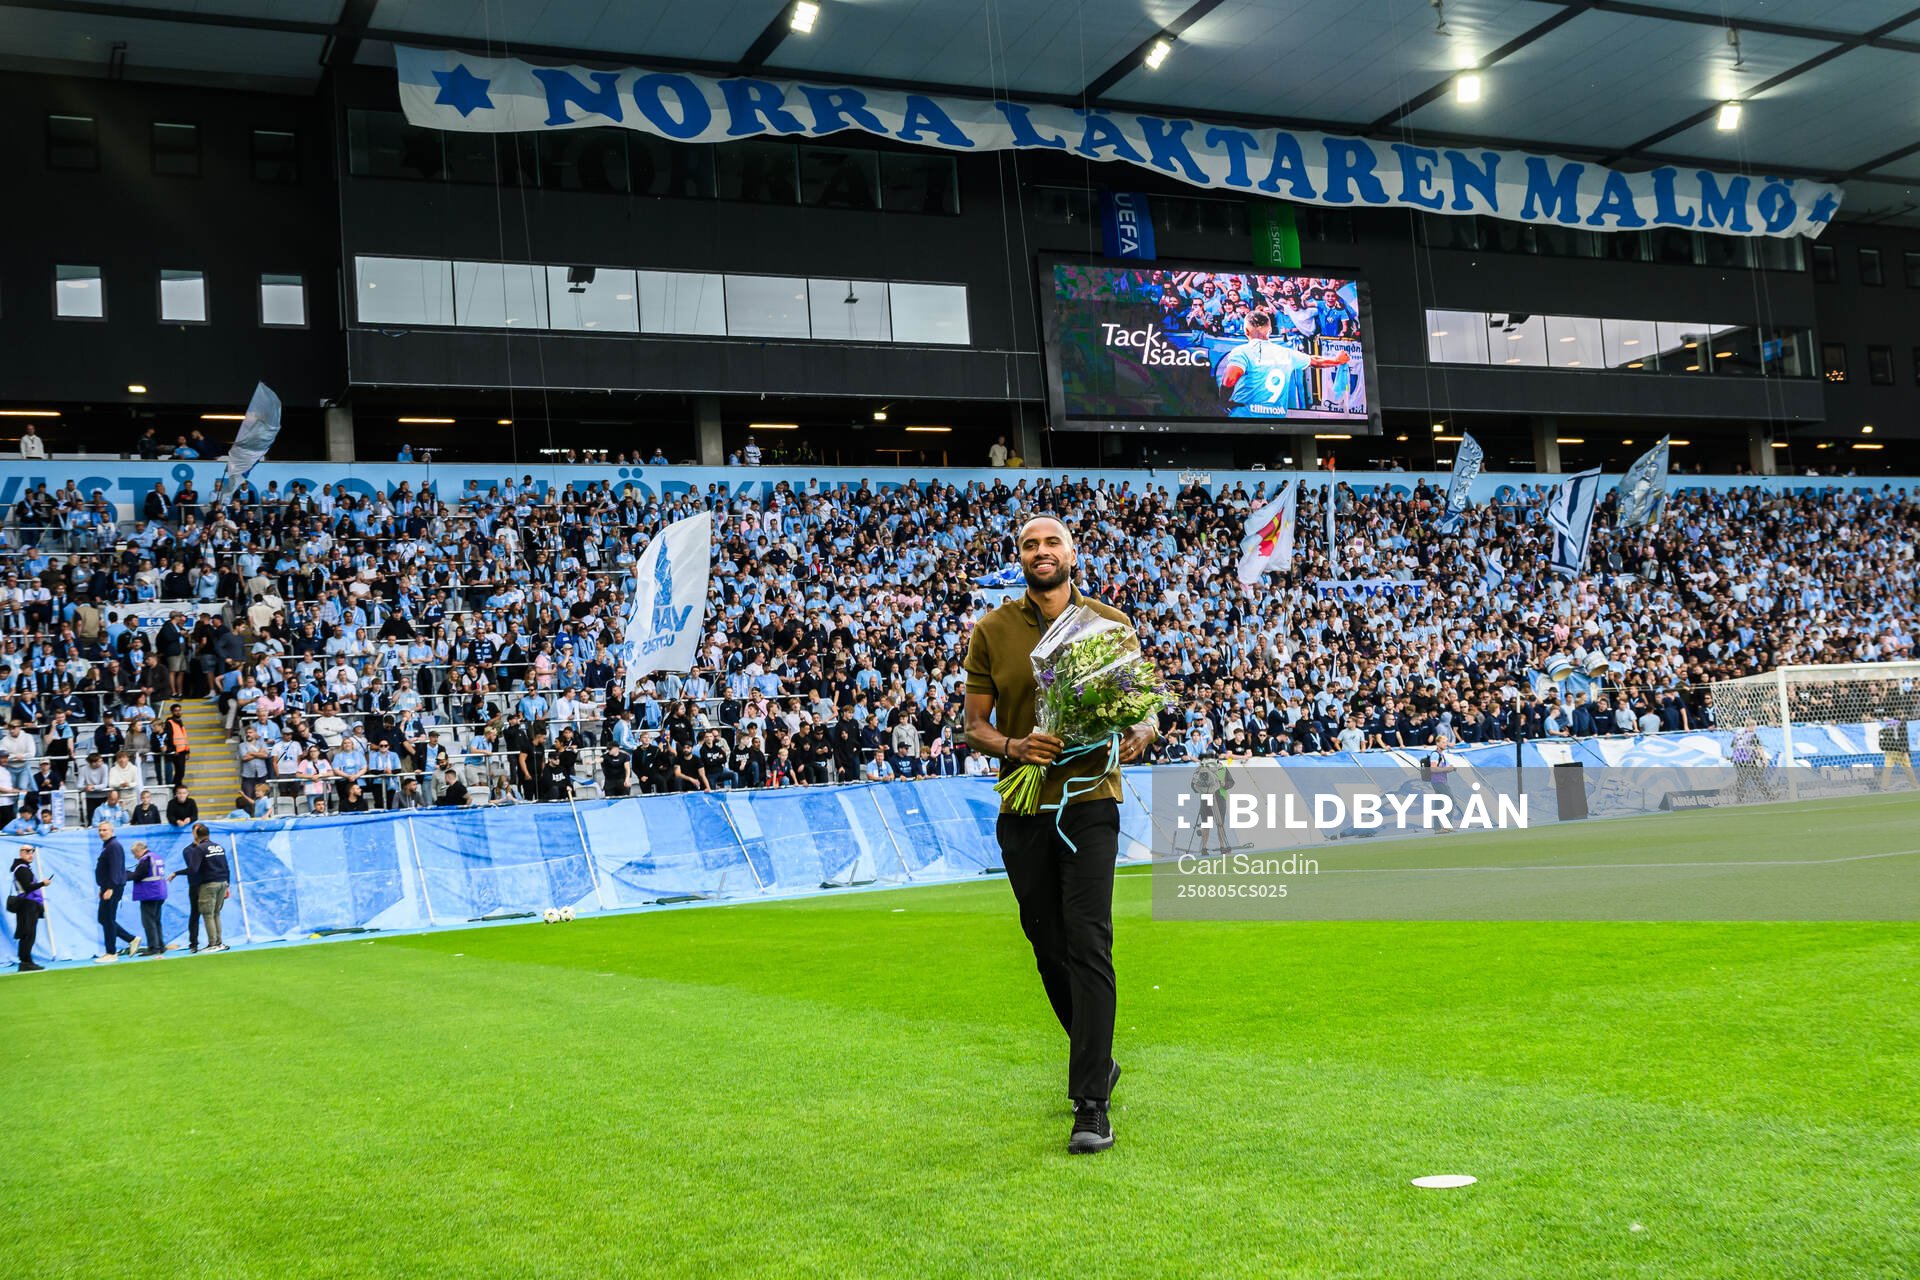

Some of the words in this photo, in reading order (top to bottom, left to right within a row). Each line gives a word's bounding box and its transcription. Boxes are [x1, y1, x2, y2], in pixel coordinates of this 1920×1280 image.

[532, 69, 975, 147] NORRA
[996, 101, 1501, 212] LÄKTAREN
[1520, 156, 1798, 232] MALMÖ
[1114, 192, 1139, 255] UEFA
[1264, 368, 1286, 404] 9
